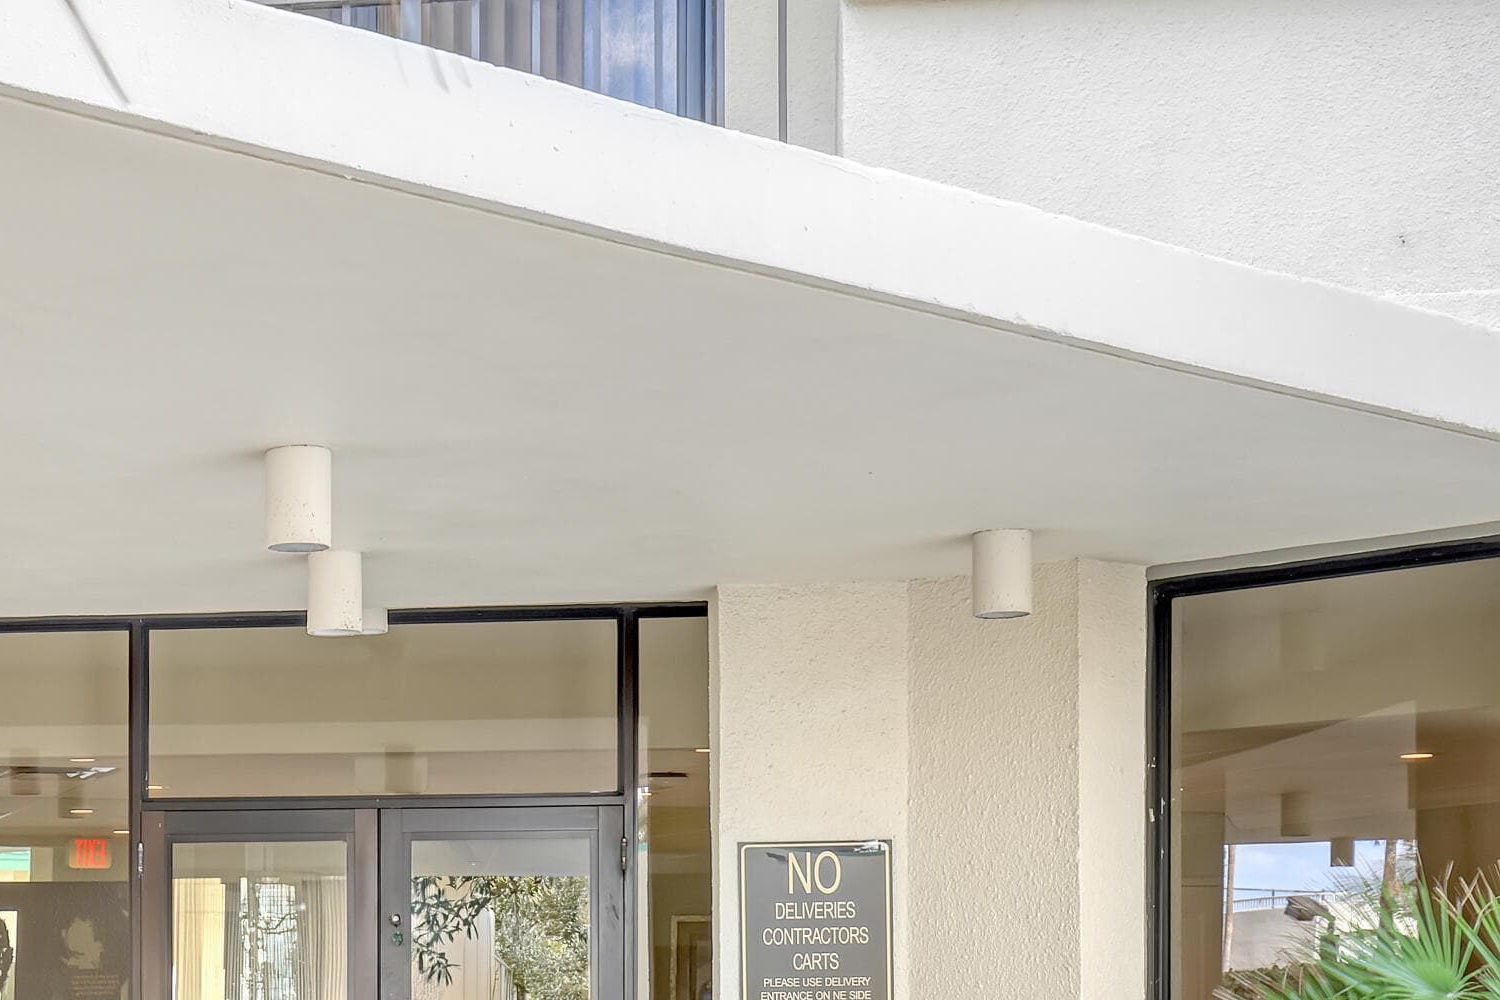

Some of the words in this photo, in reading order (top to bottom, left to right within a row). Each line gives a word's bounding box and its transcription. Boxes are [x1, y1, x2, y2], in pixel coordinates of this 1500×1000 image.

[787, 850, 842, 895] NO
[775, 901, 856, 920] DELIVERIES
[762, 926, 870, 945] CONTRACTORS
[792, 952, 840, 971] CARTS
[763, 977, 800, 988] PLEASE
[802, 976, 823, 987] USE
[824, 976, 872, 987] DELIVERY
[760, 990, 813, 1000] ENTRANCE
[815, 990, 831, 1000] ON
[832, 990, 847, 1000] NE
[848, 990, 872, 1000] SIDE
